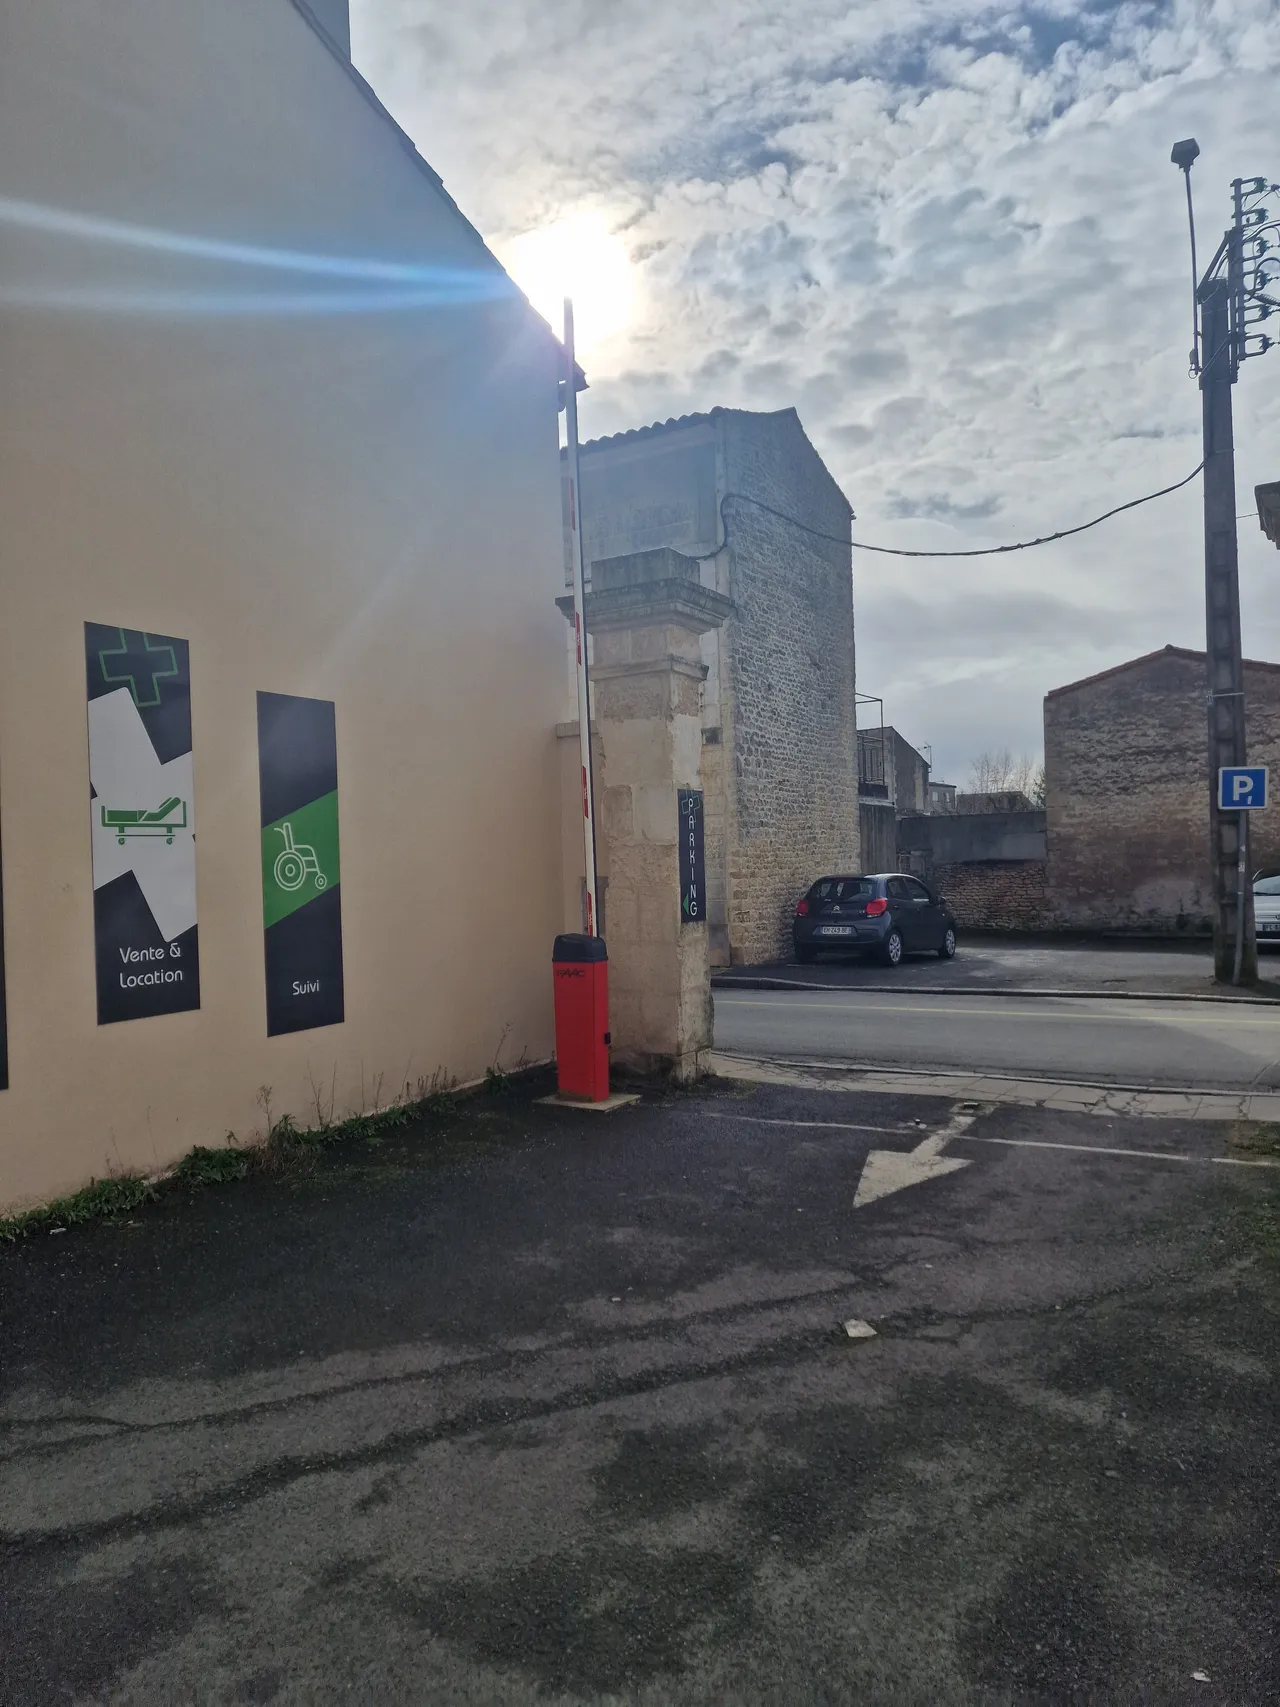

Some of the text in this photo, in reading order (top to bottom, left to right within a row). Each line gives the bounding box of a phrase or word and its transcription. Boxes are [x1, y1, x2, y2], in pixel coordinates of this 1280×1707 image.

[1233, 775, 1254, 801] P
[688, 798, 698, 916] PARKING
[119, 942, 181, 964] Vente &
[119, 969, 183, 988] Location
[292, 979, 320, 996] Suivi
